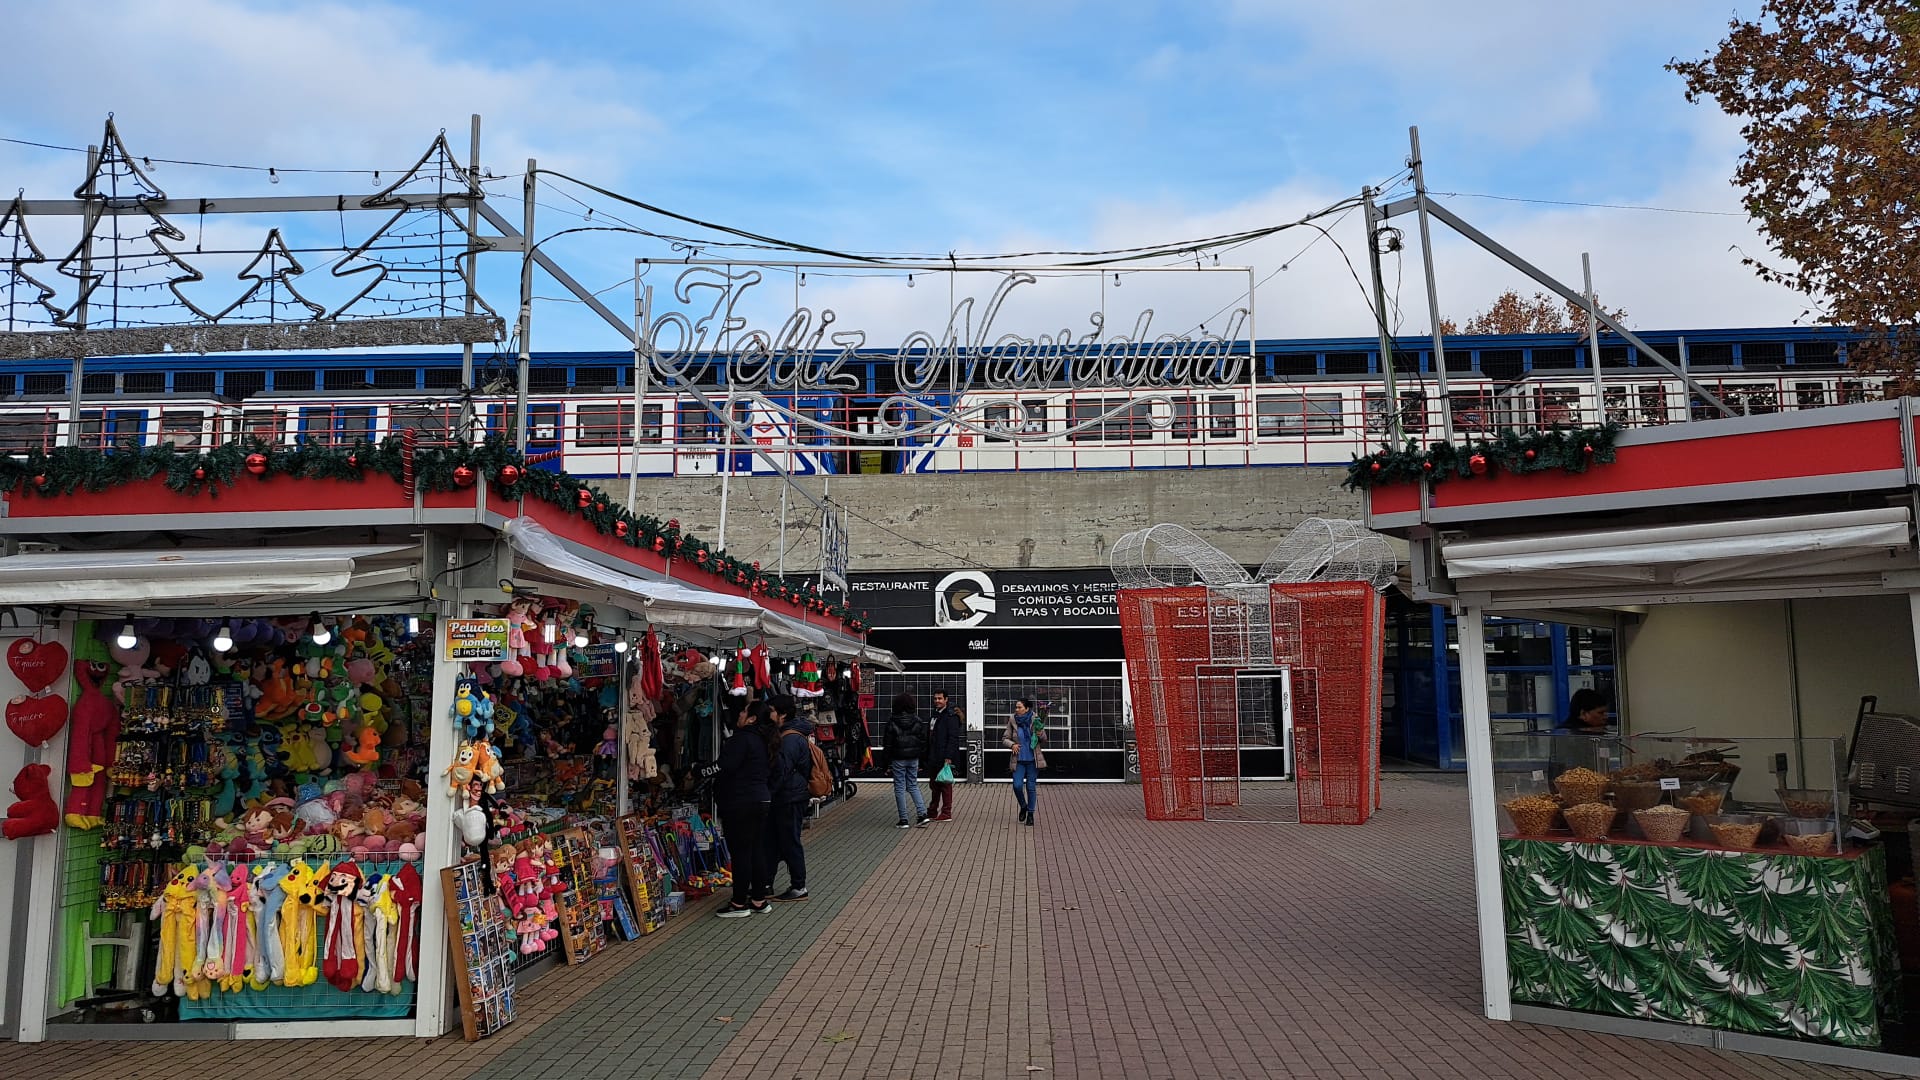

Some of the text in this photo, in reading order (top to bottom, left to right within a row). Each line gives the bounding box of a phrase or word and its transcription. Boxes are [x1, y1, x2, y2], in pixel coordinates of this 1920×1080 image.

[852, 582, 929, 591] RESTAURANTE
[1002, 584, 1069, 593] DESAYUNOS
[1072, 584, 1080, 593] Y
[1018, 596, 1072, 605] COMIDAS
[1011, 608, 1048, 616] TAPAS
[1052, 607, 1060, 616] Y
[449, 622, 504, 633] Peluches
[462, 638, 502, 647] nombre
[968, 638, 989, 646] AQUÍ
[463, 646, 501, 656] instante
[967, 740, 978, 774] AQUÍ
